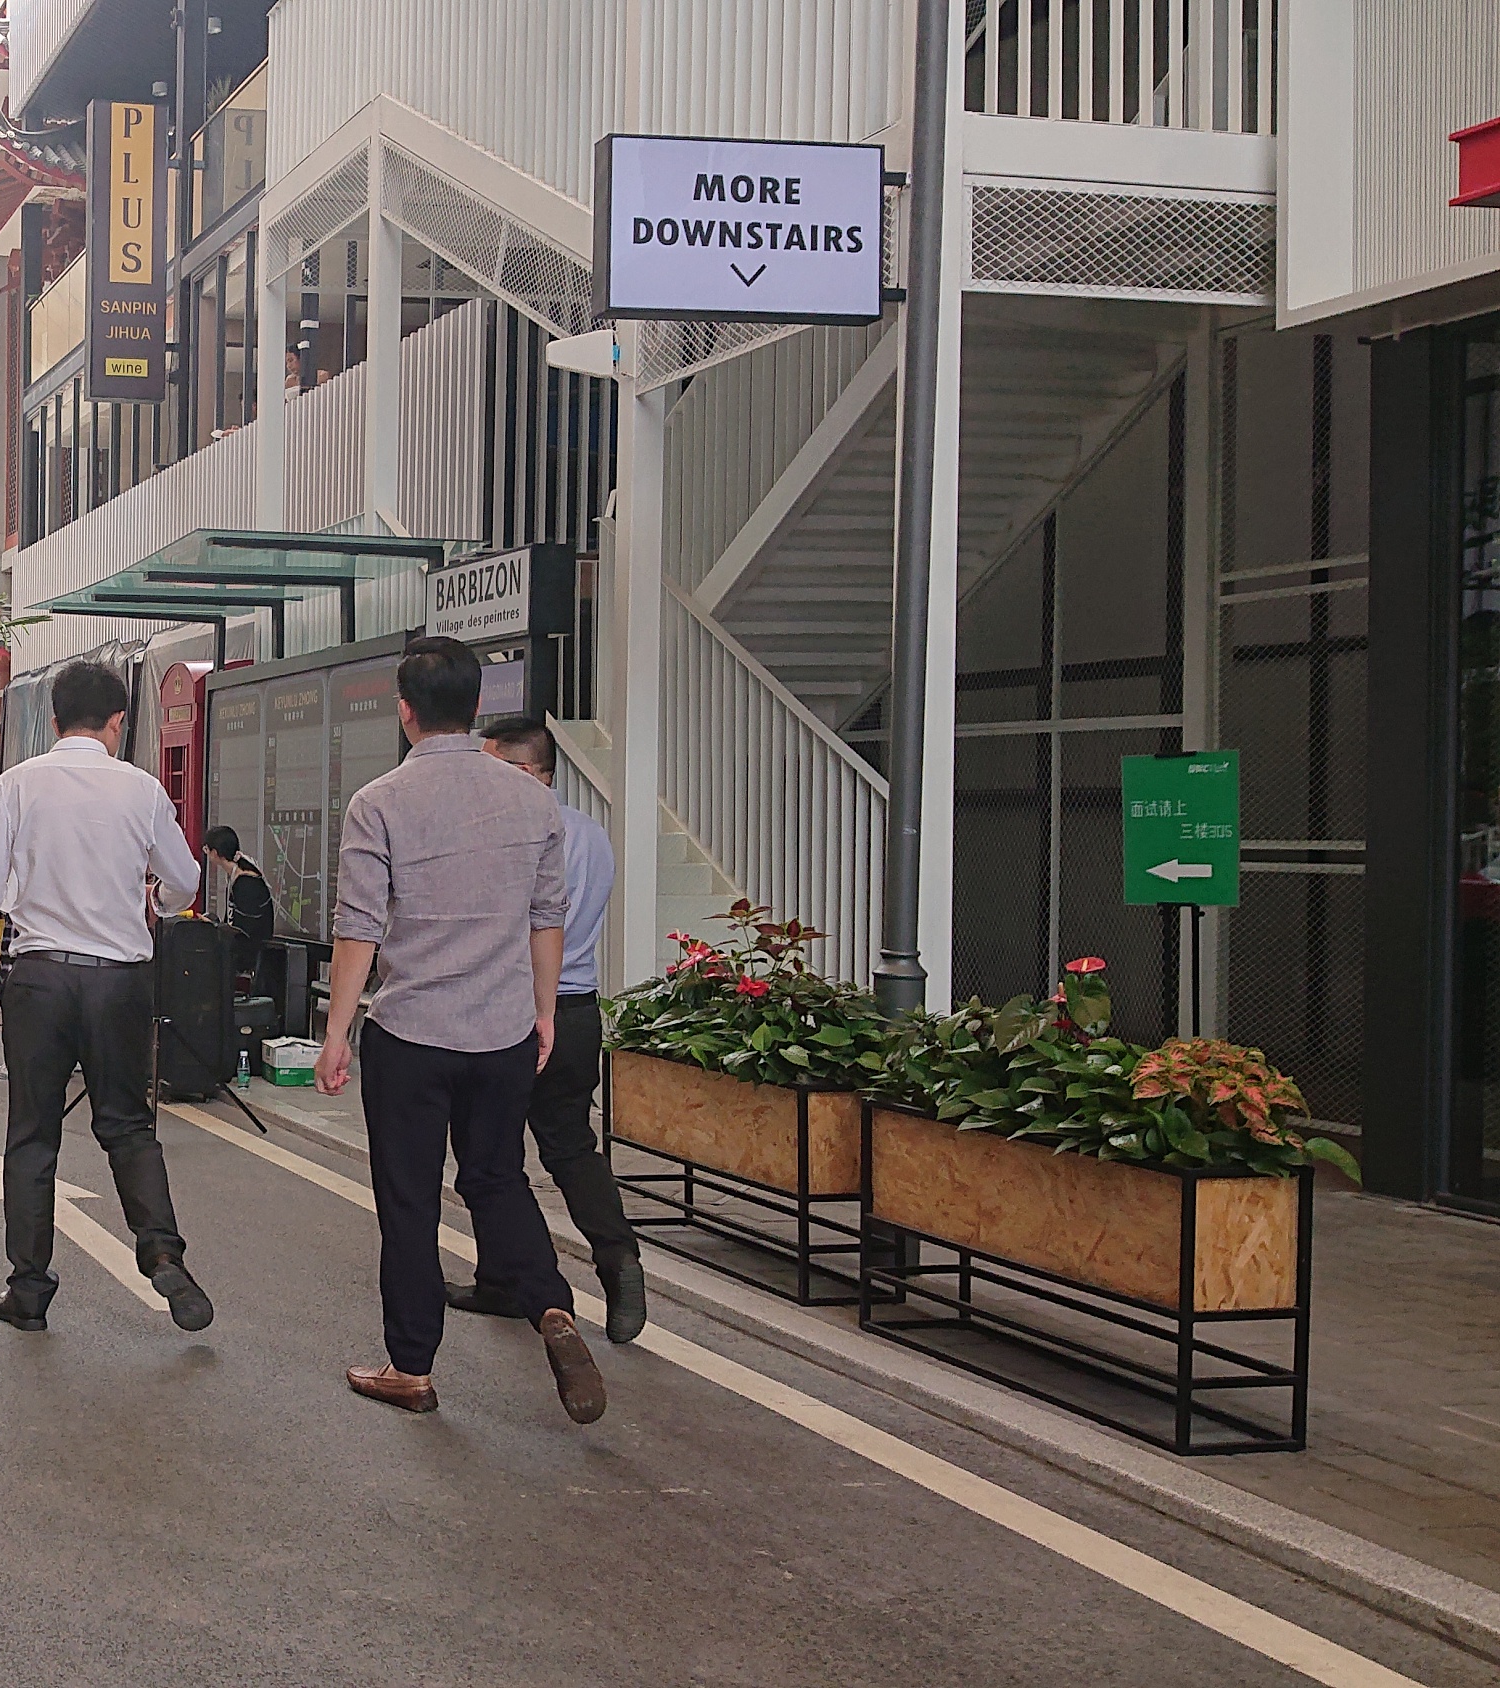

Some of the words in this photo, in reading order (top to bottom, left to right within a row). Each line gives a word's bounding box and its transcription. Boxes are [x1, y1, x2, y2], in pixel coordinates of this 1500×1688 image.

[121, 107, 143, 273] PLUS
[693, 173, 801, 205] MORE
[632, 217, 864, 254] DOWNSTAIRS
[100, 300, 157, 315] SANPIN
[105, 326, 151, 340] JIHUA
[111, 362, 143, 374] wine
[436, 558, 522, 612] BARBIZON
[436, 619, 464, 634] Village
[467, 614, 482, 628] des
[483, 608, 520, 629] peintres
[1130, 799, 1188, 818] 面试请上
